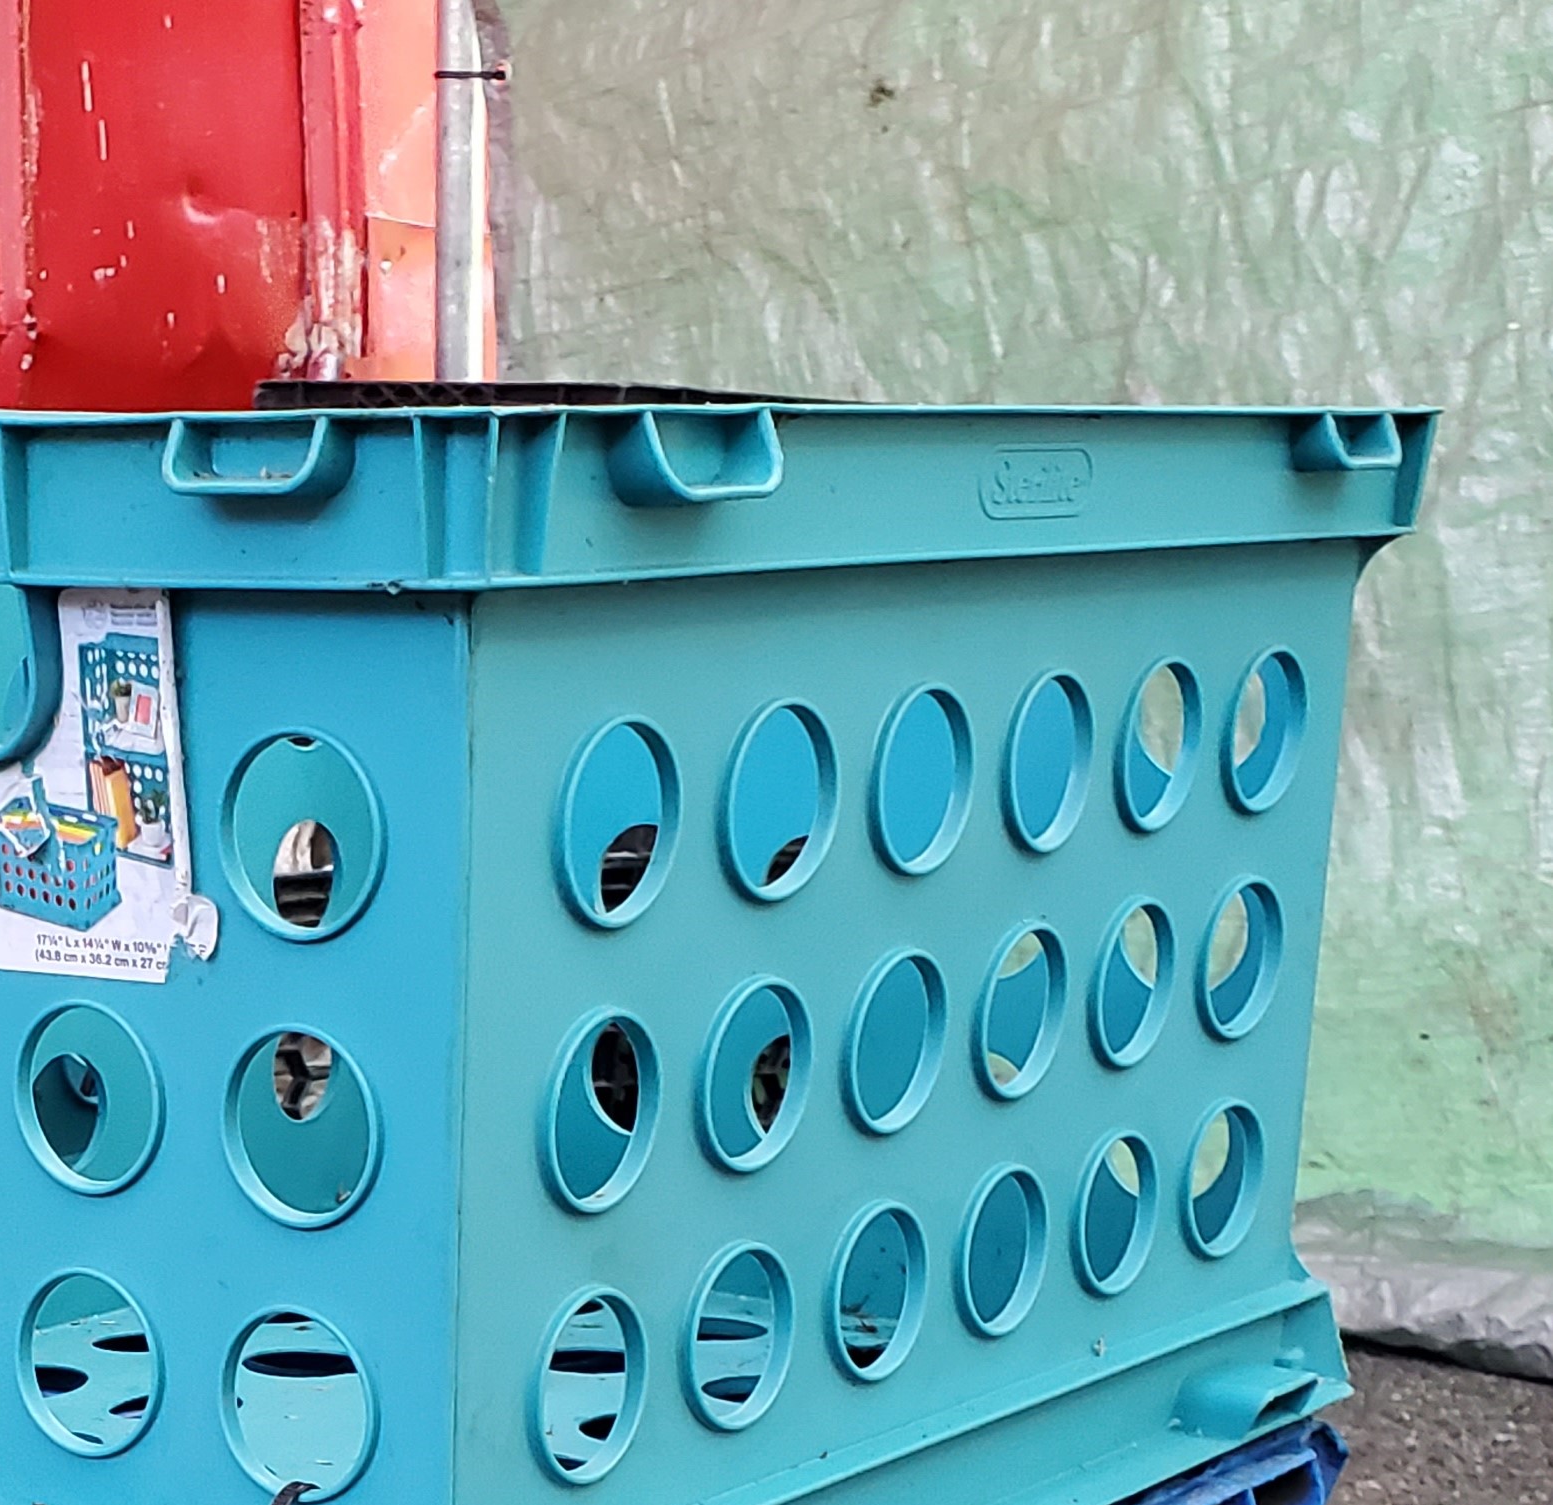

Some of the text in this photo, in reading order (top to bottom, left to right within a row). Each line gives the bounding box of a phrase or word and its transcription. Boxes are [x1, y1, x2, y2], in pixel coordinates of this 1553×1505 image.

[66, 936, 71, 947] L
[74, 939, 79, 947] x
[112, 940, 121, 951] W
[64, 953, 78, 963] cm
[81, 954, 86, 963] x
[114, 957, 130, 967] cm
[132, 959, 138, 968] x
[140, 957, 153, 969] 27
